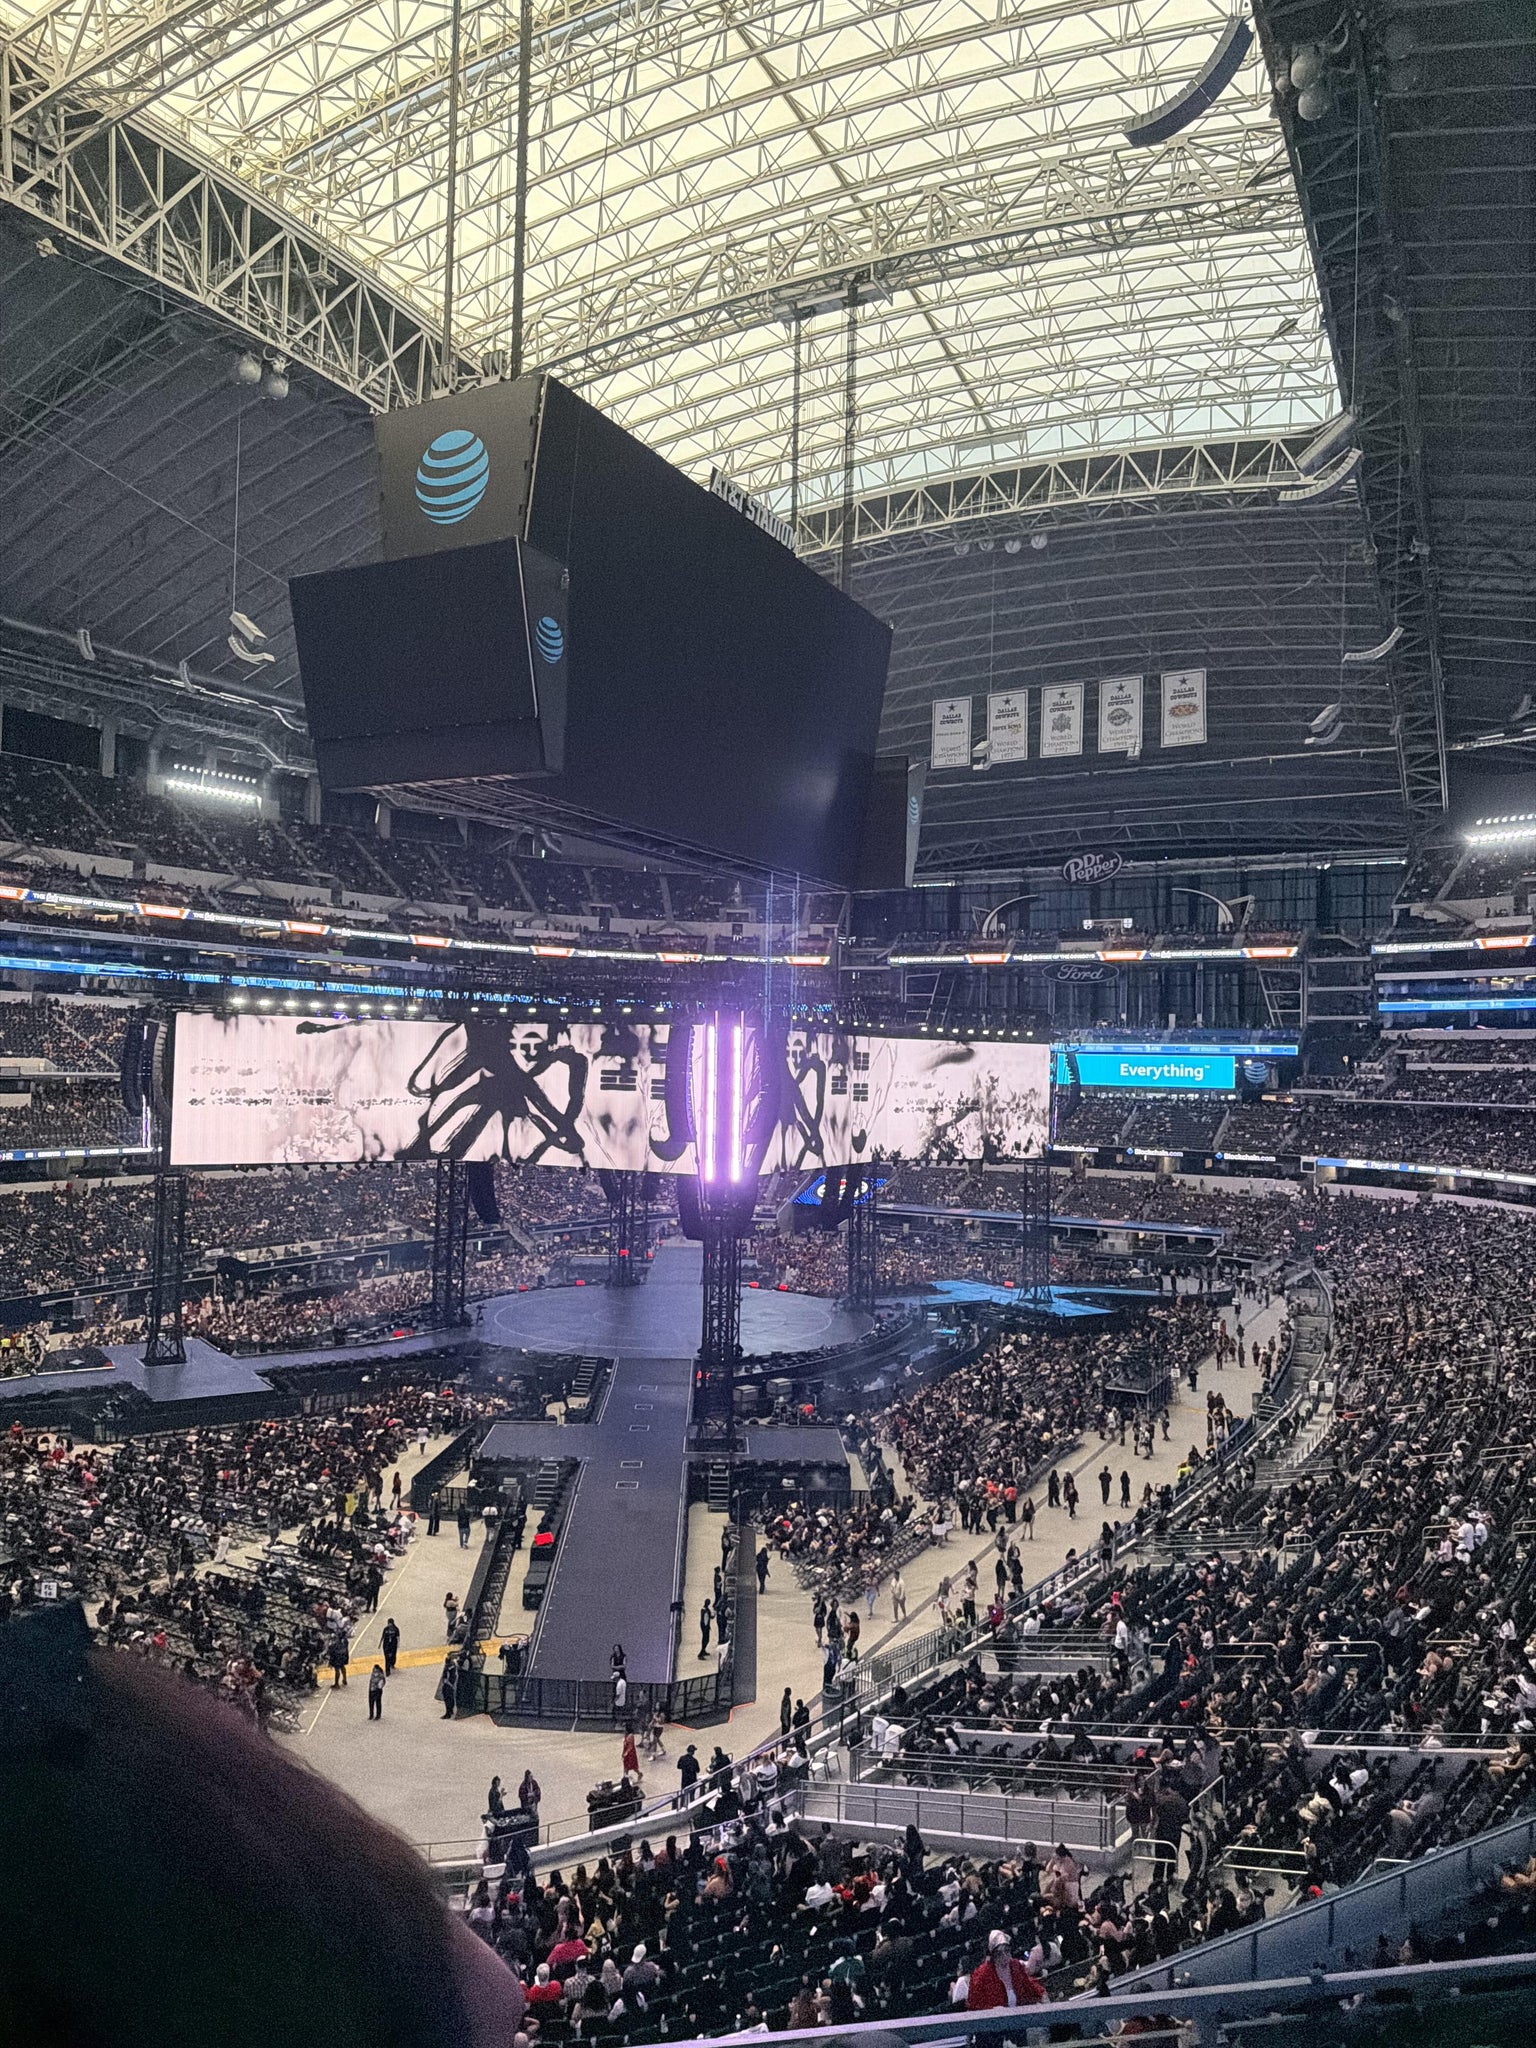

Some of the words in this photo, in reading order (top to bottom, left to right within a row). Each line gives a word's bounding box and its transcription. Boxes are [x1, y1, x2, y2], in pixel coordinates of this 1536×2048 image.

[711, 472, 746, 513] AT&T
[745, 496, 798, 550] STADIUM
[1082, 854, 1104, 868] Dr
[1064, 858, 1118, 882] Pepper
[1057, 964, 1103, 980] Ford
[1120, 1063, 1204, 1081] Everything
[1134, 1149, 1183, 1157] Blockchain.com
[1224, 1153, 1276, 1161] Blockchain.com
